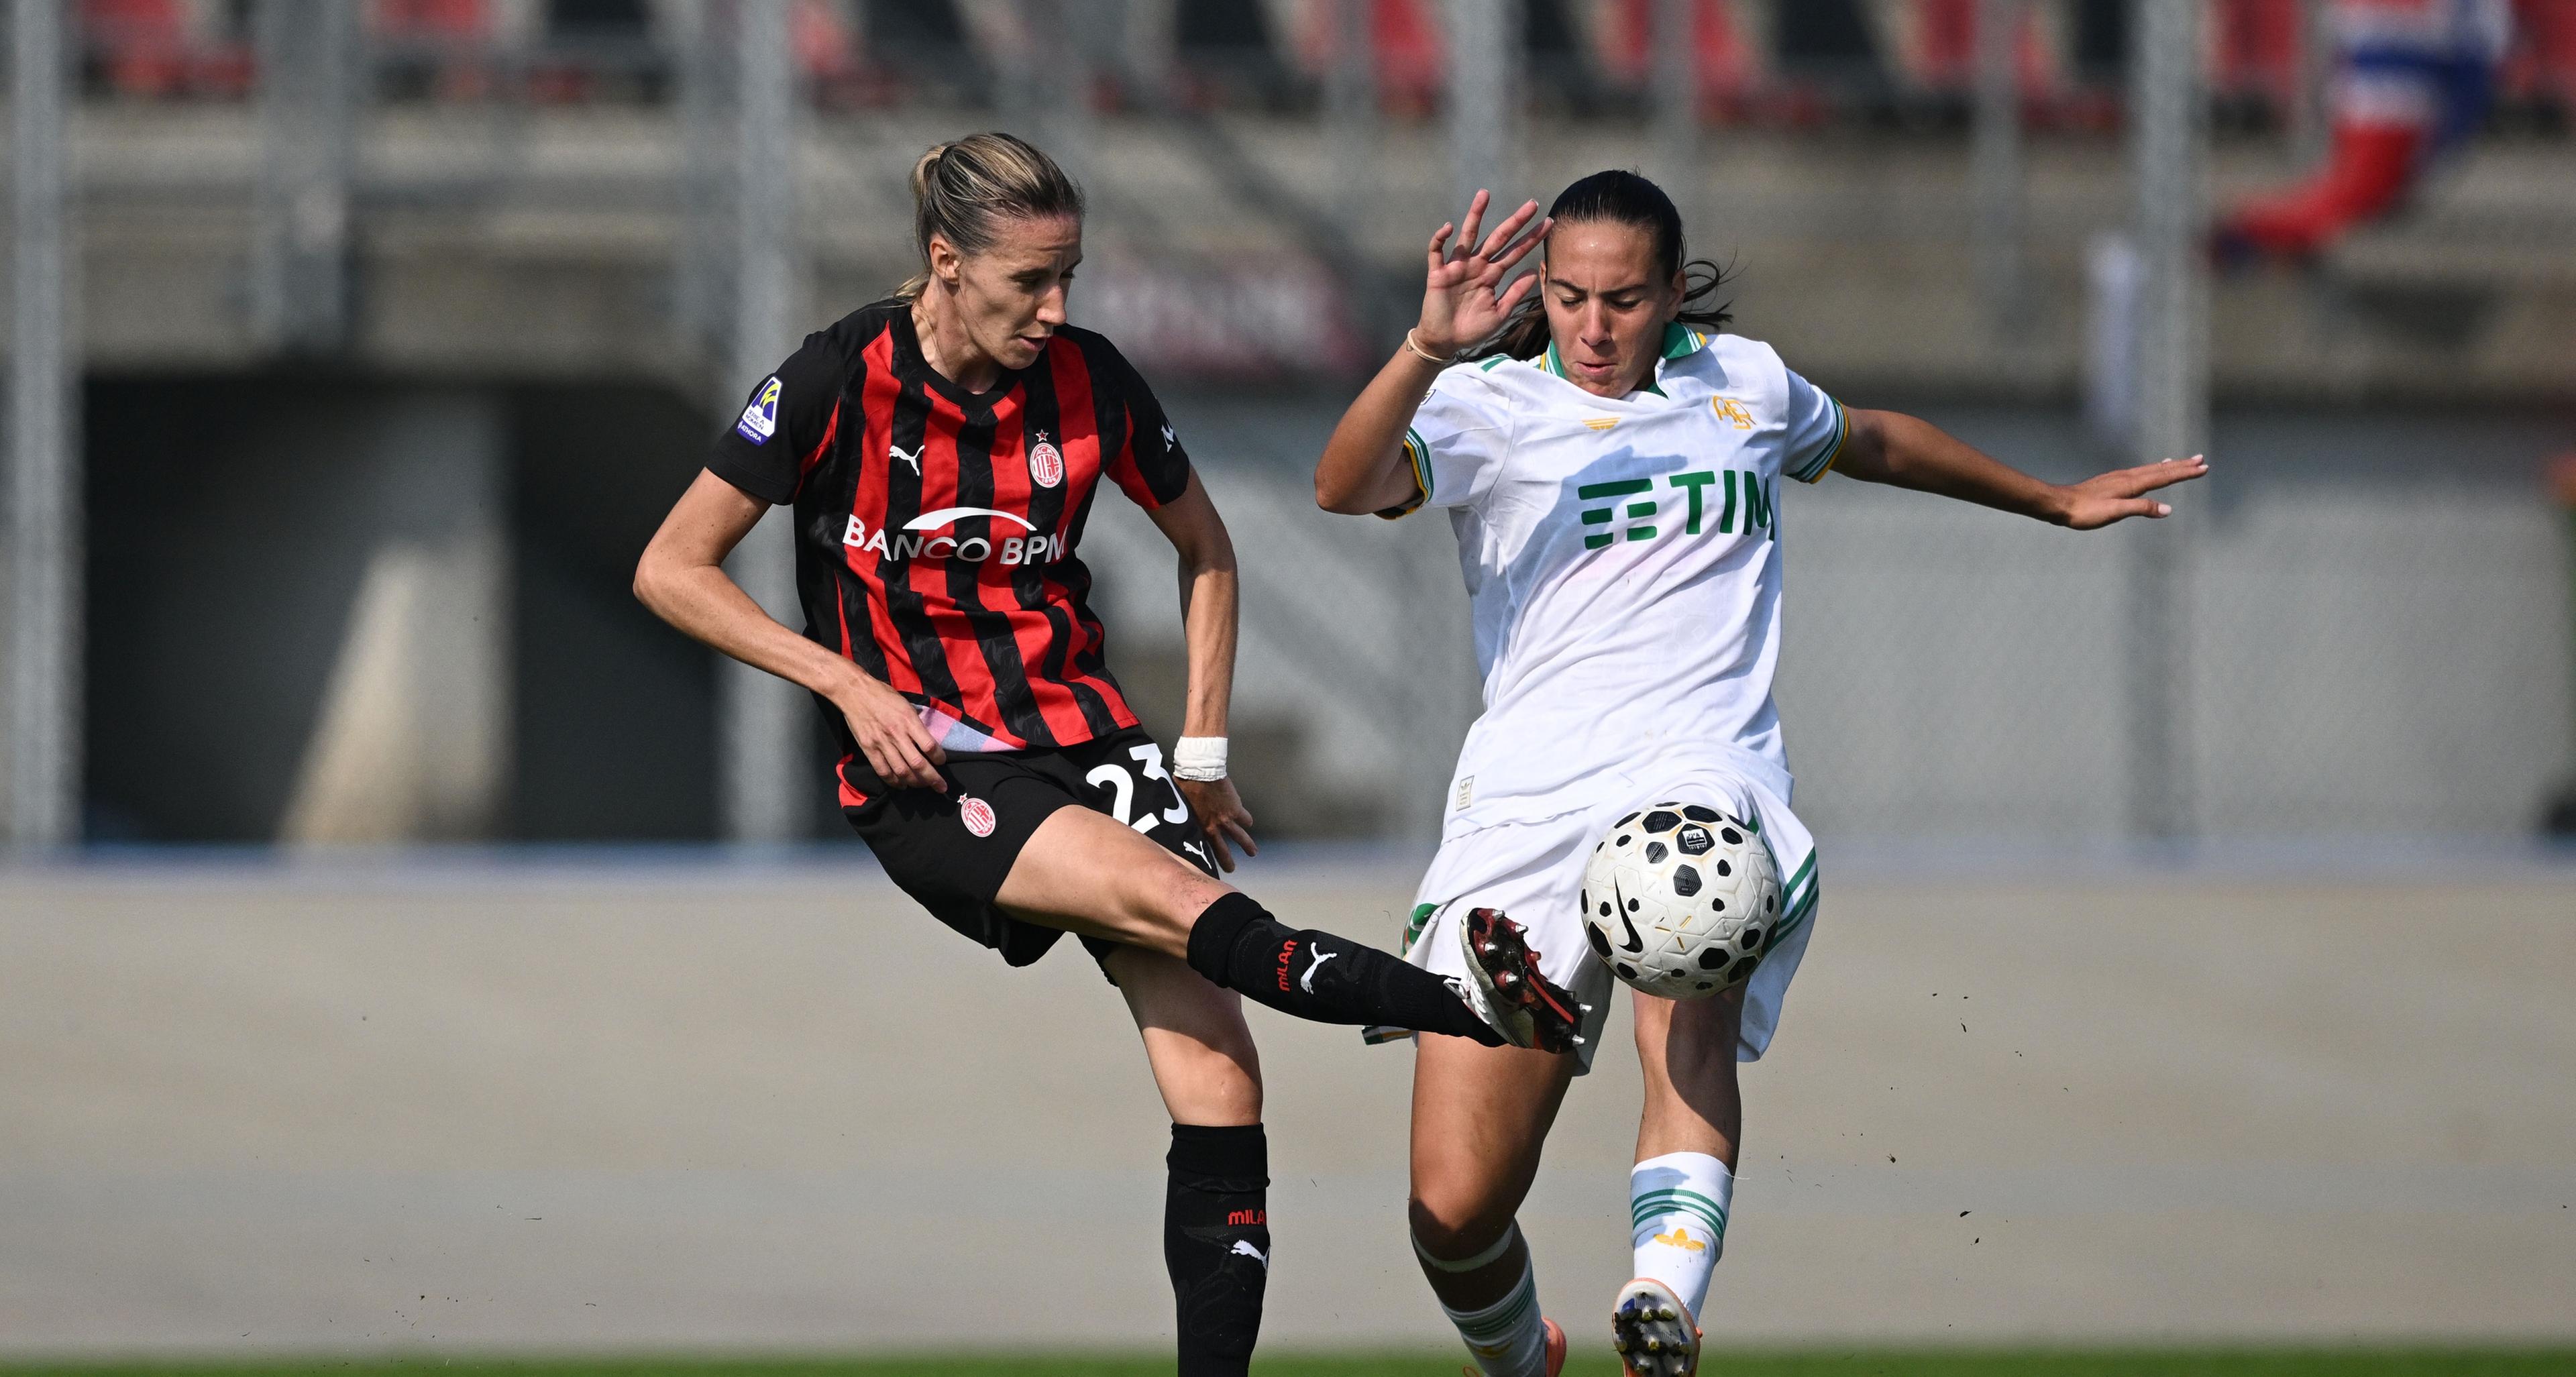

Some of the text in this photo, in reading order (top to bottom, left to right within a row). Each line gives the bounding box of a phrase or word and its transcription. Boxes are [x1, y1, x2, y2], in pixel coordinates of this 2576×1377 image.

[741, 425, 761, 442] ATHORA
[1036, 447, 1053, 456] ACM
[1668, 470, 1775, 541] TIM
[842, 514, 1069, 565] BANCO BPM
[1085, 742, 1189, 834] 23
[1228, 1209, 1267, 1225] MILA
